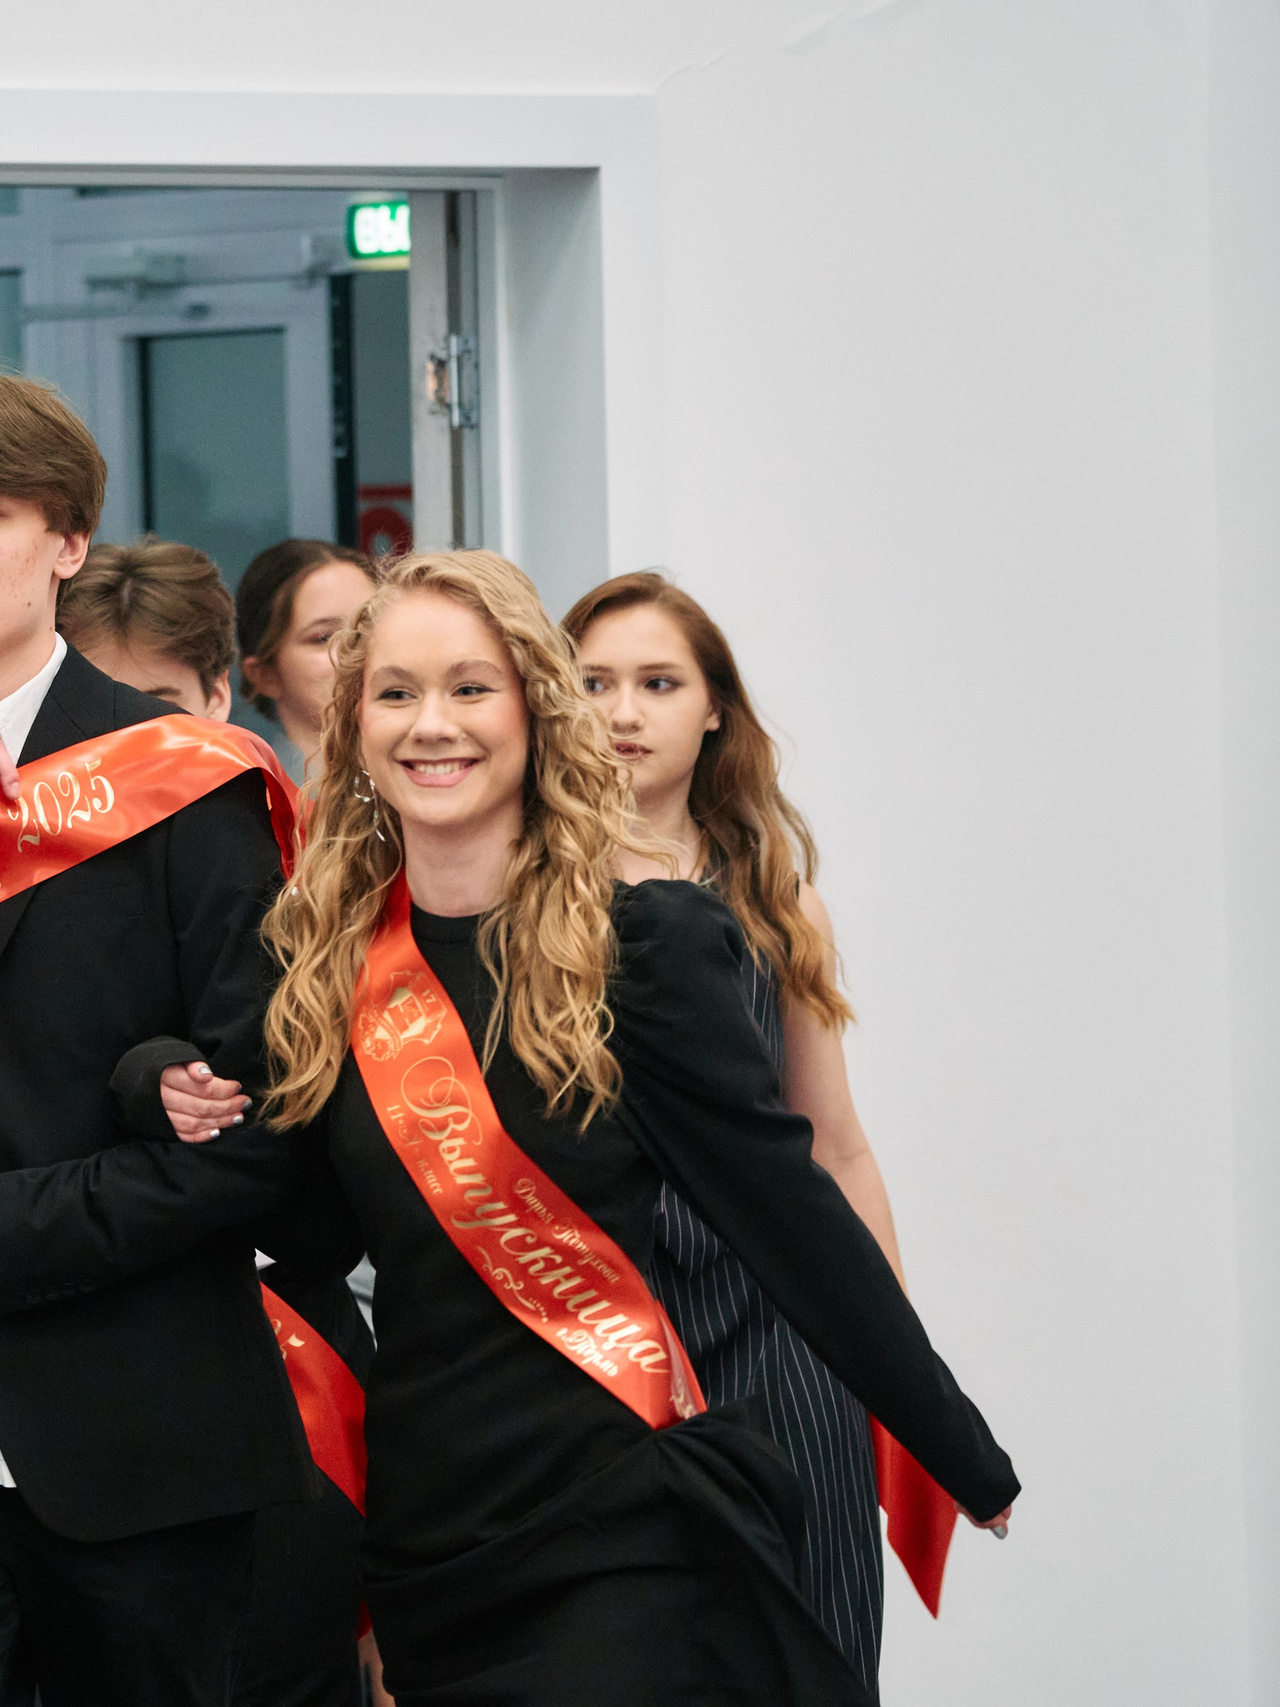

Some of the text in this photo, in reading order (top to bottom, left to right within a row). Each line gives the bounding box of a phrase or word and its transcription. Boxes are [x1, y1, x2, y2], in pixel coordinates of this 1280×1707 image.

[353, 204, 410, 254] ВЫ
[7, 757, 115, 854] 2025
[401, 1055, 671, 1374] Выпускница
